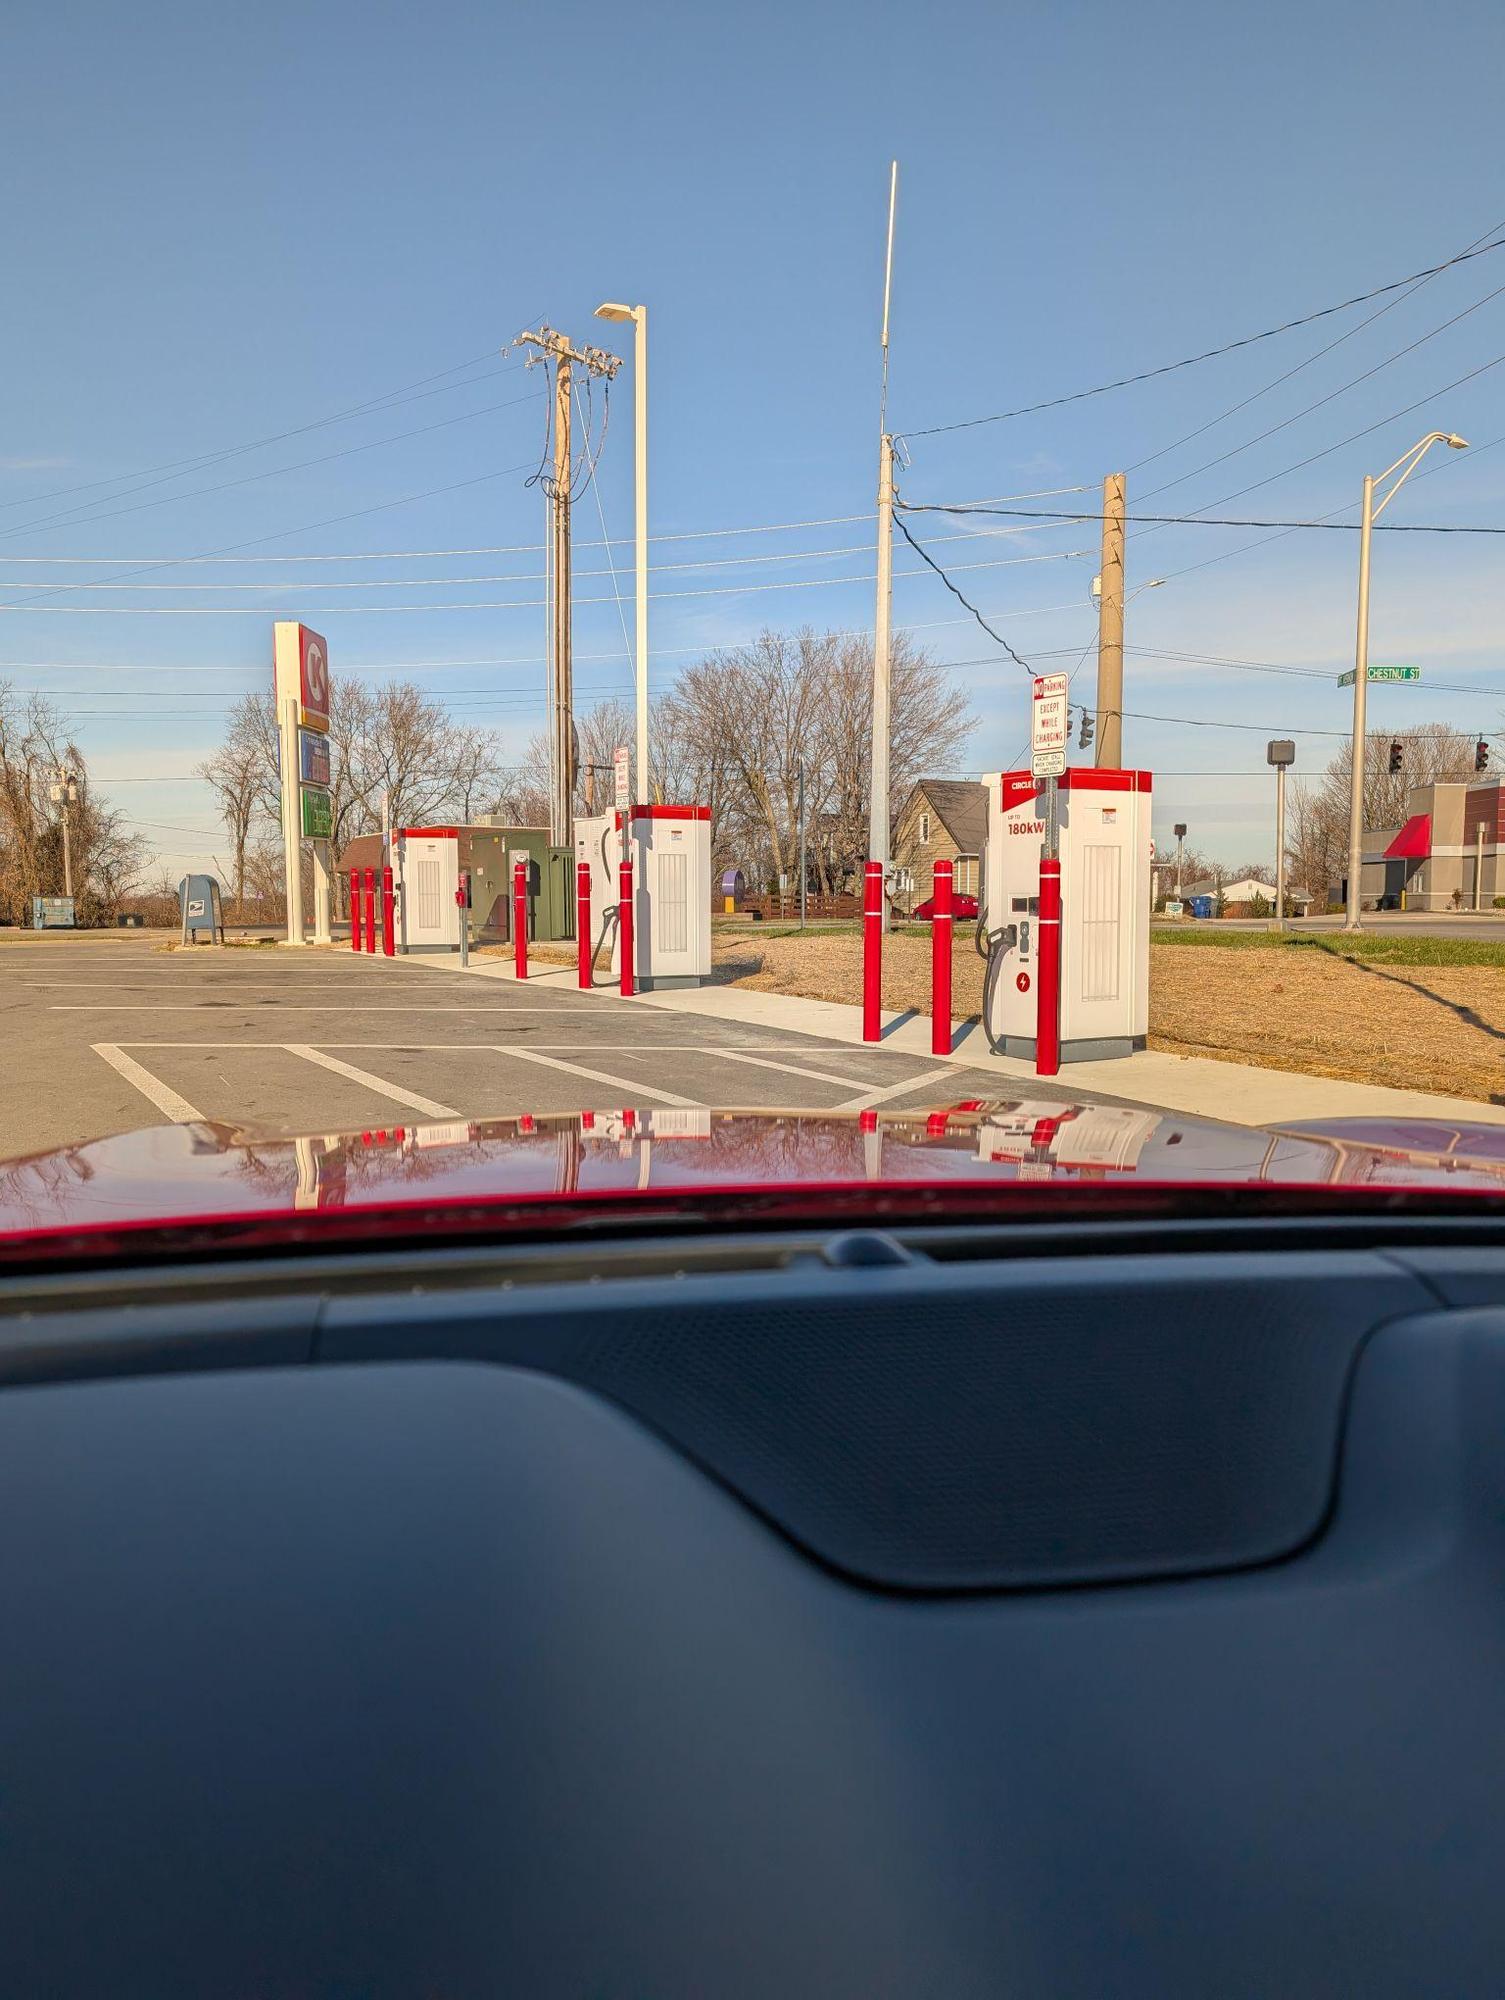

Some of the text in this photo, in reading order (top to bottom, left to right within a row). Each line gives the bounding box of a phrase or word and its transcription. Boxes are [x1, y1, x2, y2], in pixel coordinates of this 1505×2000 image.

[1368, 668, 1420, 679] CHESTNUT ST
[1044, 680, 1065, 692] PARKING
[1040, 703, 1059, 714] EXCEPT
[1041, 717, 1058, 728] WHILE
[1035, 731, 1063, 743] CHARGING
[1011, 781, 1032, 790] CIRCLE
[1008, 821, 1045, 835] 180kW
